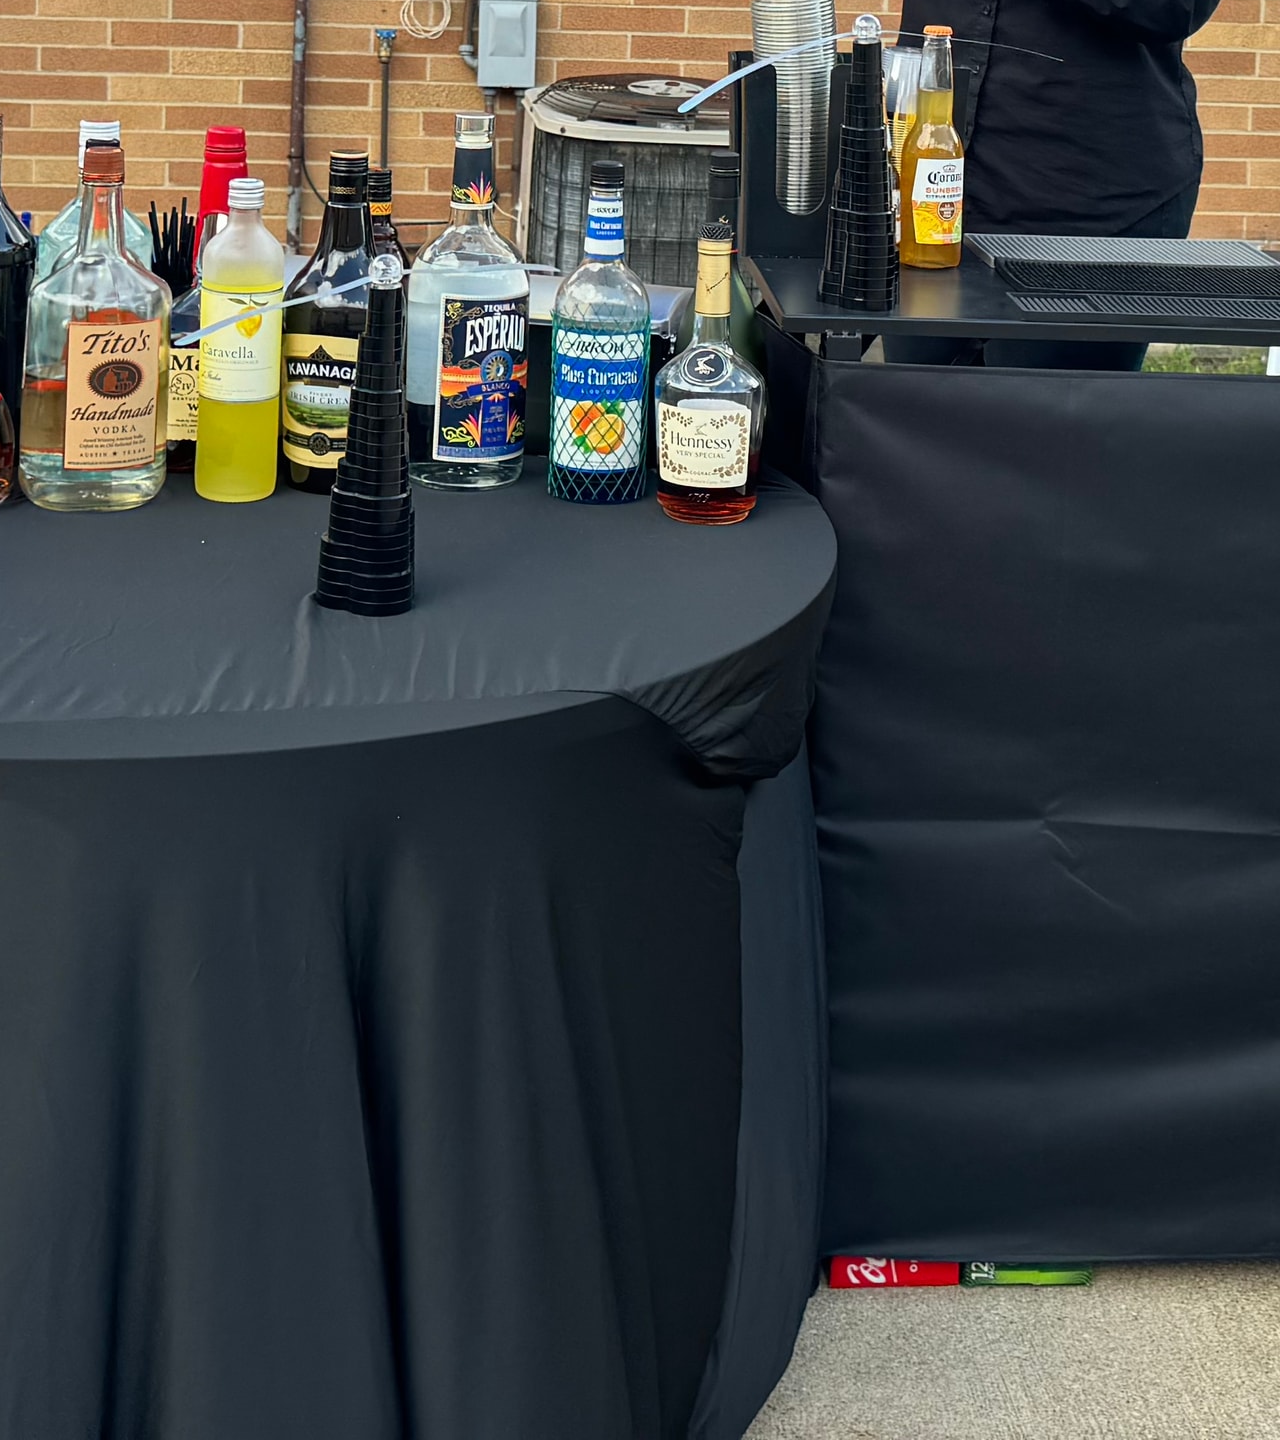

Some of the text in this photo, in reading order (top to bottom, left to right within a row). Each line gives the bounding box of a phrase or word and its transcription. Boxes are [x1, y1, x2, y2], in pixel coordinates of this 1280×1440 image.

[483, 302, 517, 315] TEQUILA
[202, 341, 254, 359] Caravella
[481, 382, 511, 392] BLANCO
[289, 391, 349, 406] IRISH CREA
[71, 397, 155, 422] Handmade
[93, 424, 137, 435] VODKA
[671, 430, 735, 453] Hennessy
[676, 449, 726, 460] VERY SPECIAL
[970, 1261, 989, 1281] 12
